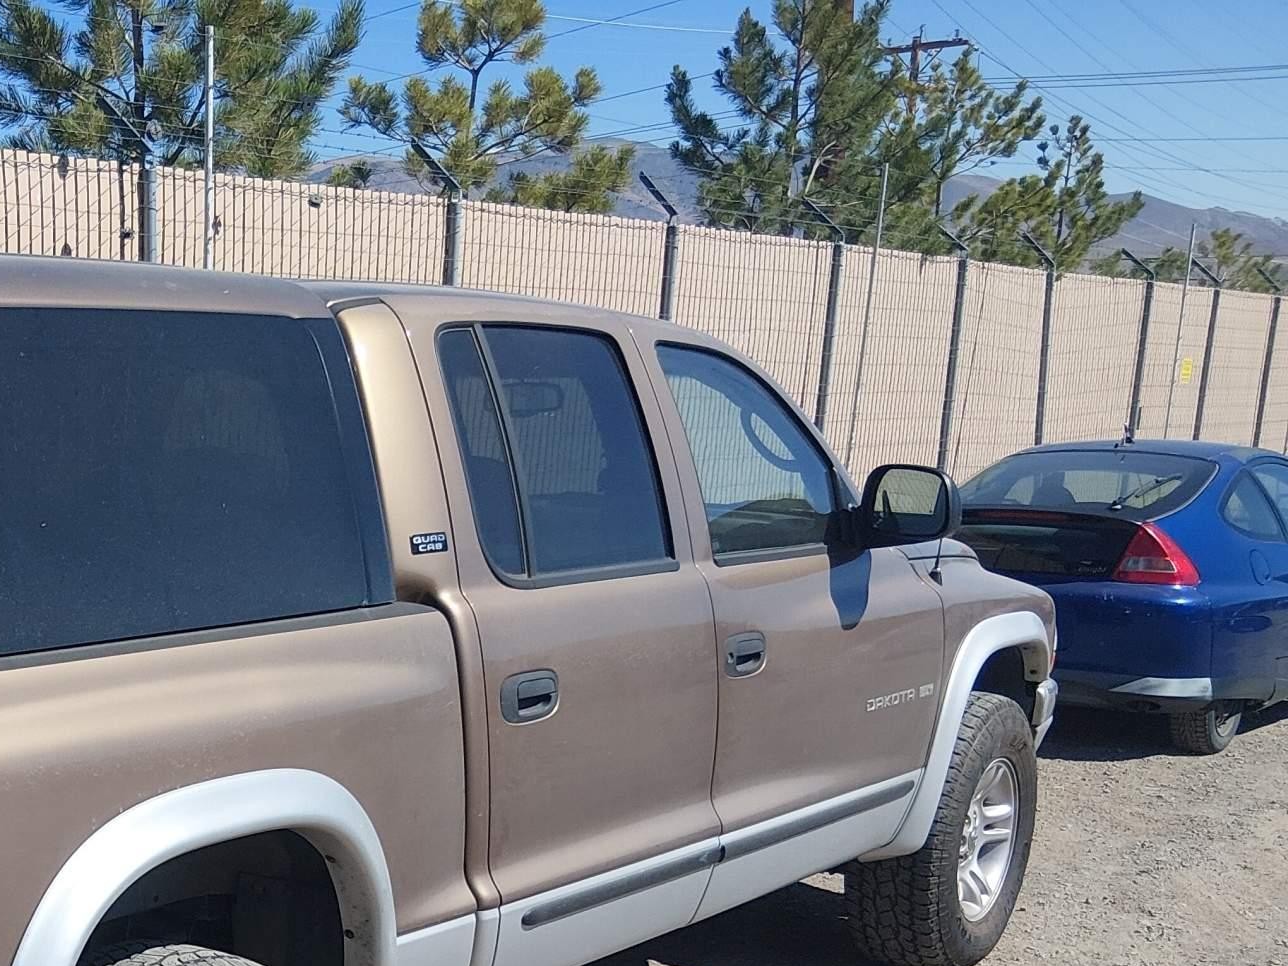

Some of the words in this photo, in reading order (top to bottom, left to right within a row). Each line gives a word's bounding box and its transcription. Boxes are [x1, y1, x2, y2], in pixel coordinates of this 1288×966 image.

[412, 534, 446, 545] QUAD
[418, 542, 444, 552] CAB
[866, 688, 916, 713] DAKOTA
